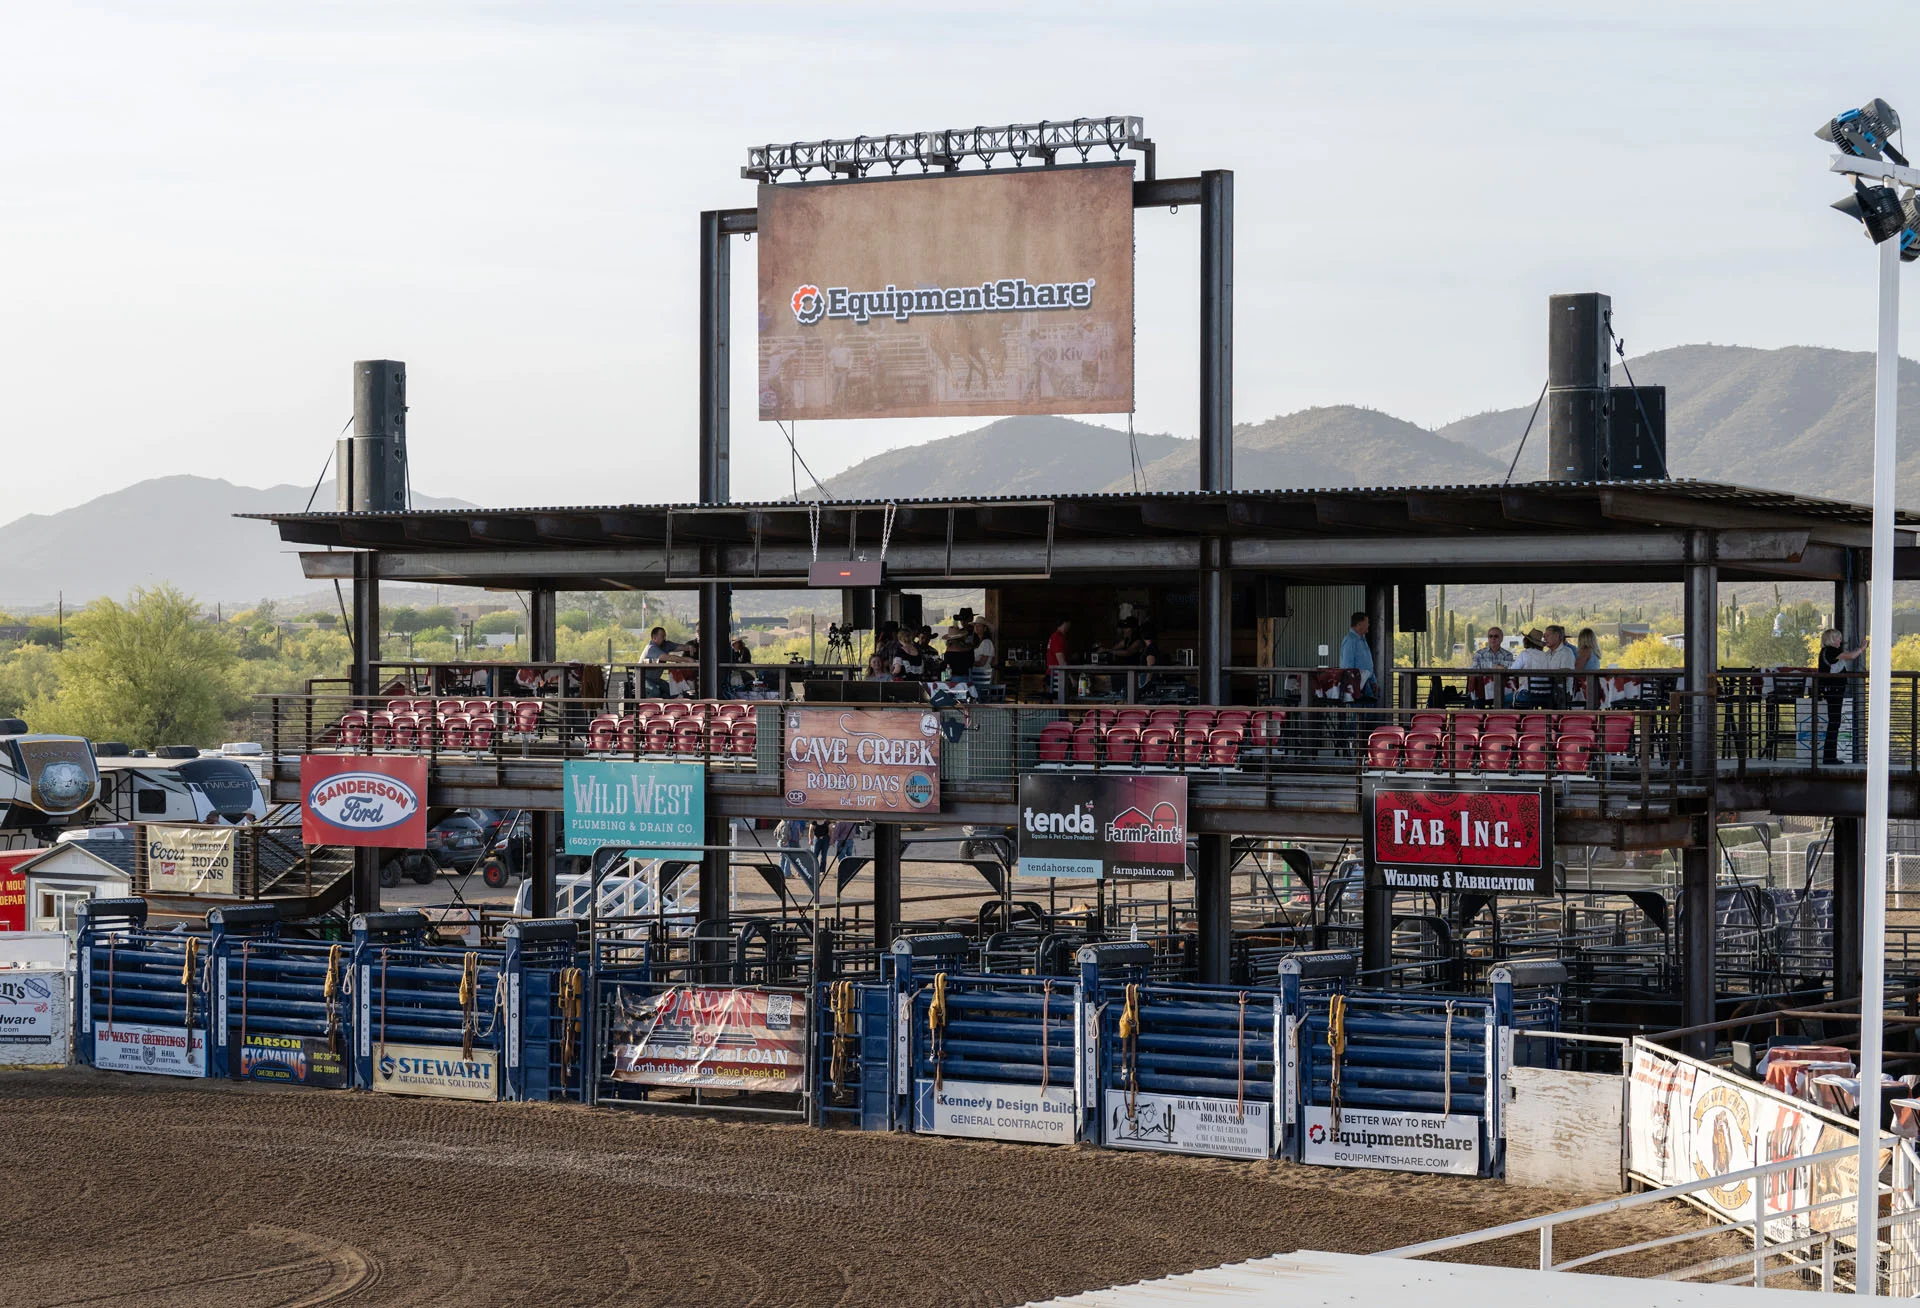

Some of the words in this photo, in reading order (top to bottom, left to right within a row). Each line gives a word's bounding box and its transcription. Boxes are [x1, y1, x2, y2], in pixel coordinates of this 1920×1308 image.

[827, 280, 1090, 320] EquipmentShare
[790, 737, 848, 765] CAVE
[856, 739, 937, 767] CREEK
[807, 773, 857, 790] RODEO
[862, 775, 899, 793] DAYS
[317, 780, 409, 809] SANDERSON
[572, 775, 628, 814] WILD
[632, 775, 693, 815] WEST
[857, 795, 877, 806] 1977
[340, 796, 384, 822] Ford
[572, 819, 626, 831] PLUMBING
[629, 822, 636, 831] &
[640, 822, 673, 833] DRAIN
[677, 824, 696, 834] CO.
[1024, 805, 1095, 834] tenda
[1393, 809, 1445, 846] FAB
[1460, 811, 1522, 848] INC.
[1105, 822, 1178, 843] FarmPaint
[150, 841, 185, 861] Coors
[1027, 863, 1095, 874] tendahorse.com
[1112, 866, 1175, 877] farmpaint.com
[1383, 869, 1439, 888] WELDING
[1442, 871, 1452, 888] &
[1455, 871, 1535, 892] FABRICATION
[0, 982, 26, 999] n's
[656, 990, 755, 1028] PAWN
[98, 1030, 110, 1042] NO
[111, 1031, 140, 1044] WASTE
[142, 1034, 186, 1048] GRINDINGS
[246, 1036, 301, 1048] LARSON
[241, 1048, 307, 1080] EXCAVATING
[675, 1045, 722, 1061] SELL
[736, 1048, 790, 1064] LOAN
[398, 1058, 492, 1080] STEWART
[627, 1063, 656, 1073] North
[658, 1064, 668, 1073] of
[669, 1064, 684, 1074] the
[702, 1068, 714, 1076] on
[716, 1066, 740, 1077] Cave
[742, 1068, 770, 1079] Creek
[773, 1070, 786, 1080] Rd
[398, 1076, 445, 1086] MECHANICAL
[941, 1094, 992, 1111] Kennedy
[996, 1098, 1038, 1114] Design
[1043, 1102, 1074, 1114] Build
[1178, 1100, 1200, 1110] BLACK
[950, 1114, 994, 1127] GENERAL
[998, 1118, 1064, 1131] CONTRACTOR
[1345, 1114, 1380, 1126] BETTER
[1382, 1116, 1402, 1126] WAY
[1406, 1118, 1418, 1128] TO
[1422, 1120, 1446, 1129] RENT
[1330, 1128, 1473, 1151] EquipmentShare
[1334, 1152, 1449, 1168] EQUIPMENTSHARE.COM
